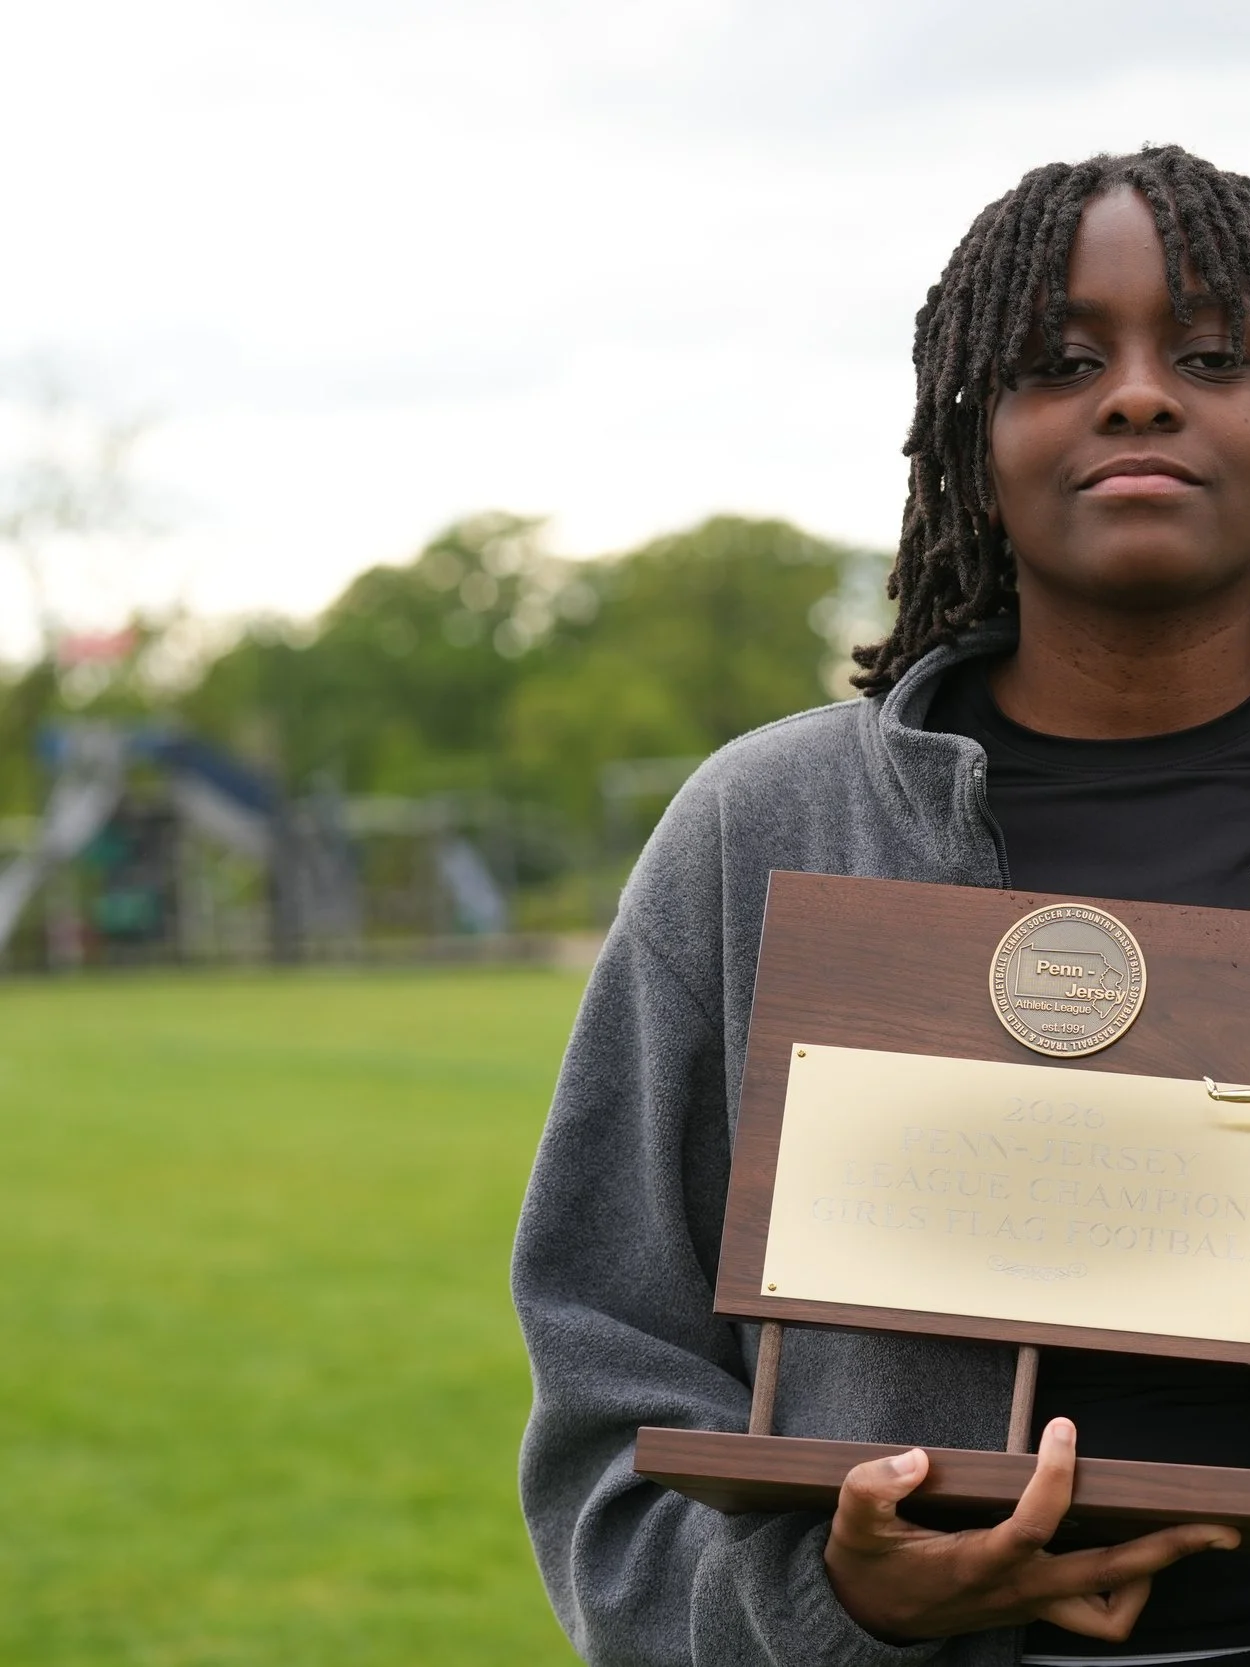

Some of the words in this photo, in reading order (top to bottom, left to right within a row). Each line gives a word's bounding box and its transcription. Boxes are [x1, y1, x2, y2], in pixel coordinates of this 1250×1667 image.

[1027, 910, 1063, 929] SOCCER
[1065, 909, 1117, 932] X-COUNTRY
[1002, 927, 1027, 955] TENNIS
[1036, 959, 1083, 977] Penn
[1114, 929, 1140, 983] BASKETBALL
[994, 956, 1009, 1013] VOLLEYBALL
[1065, 983, 1127, 1004] Jersey
[1015, 1000, 1053, 1011] Athletic
[1054, 1002, 1092, 1016] League
[1112, 986, 1140, 1027] SOFTBALL
[1006, 1014, 1029, 1036] FIELD
[1037, 1038, 1068, 1051] TRACK
[1071, 1027, 1115, 1050] BASEBALL
[1000, 1097, 1106, 1130] 2026
[900, 1126, 1201, 1178] PENN-JERSEY
[842, 1160, 1012, 1202] LEAGUE
[811, 1196, 927, 1231] GIRLS
[945, 1208, 1049, 1244] FLAG
